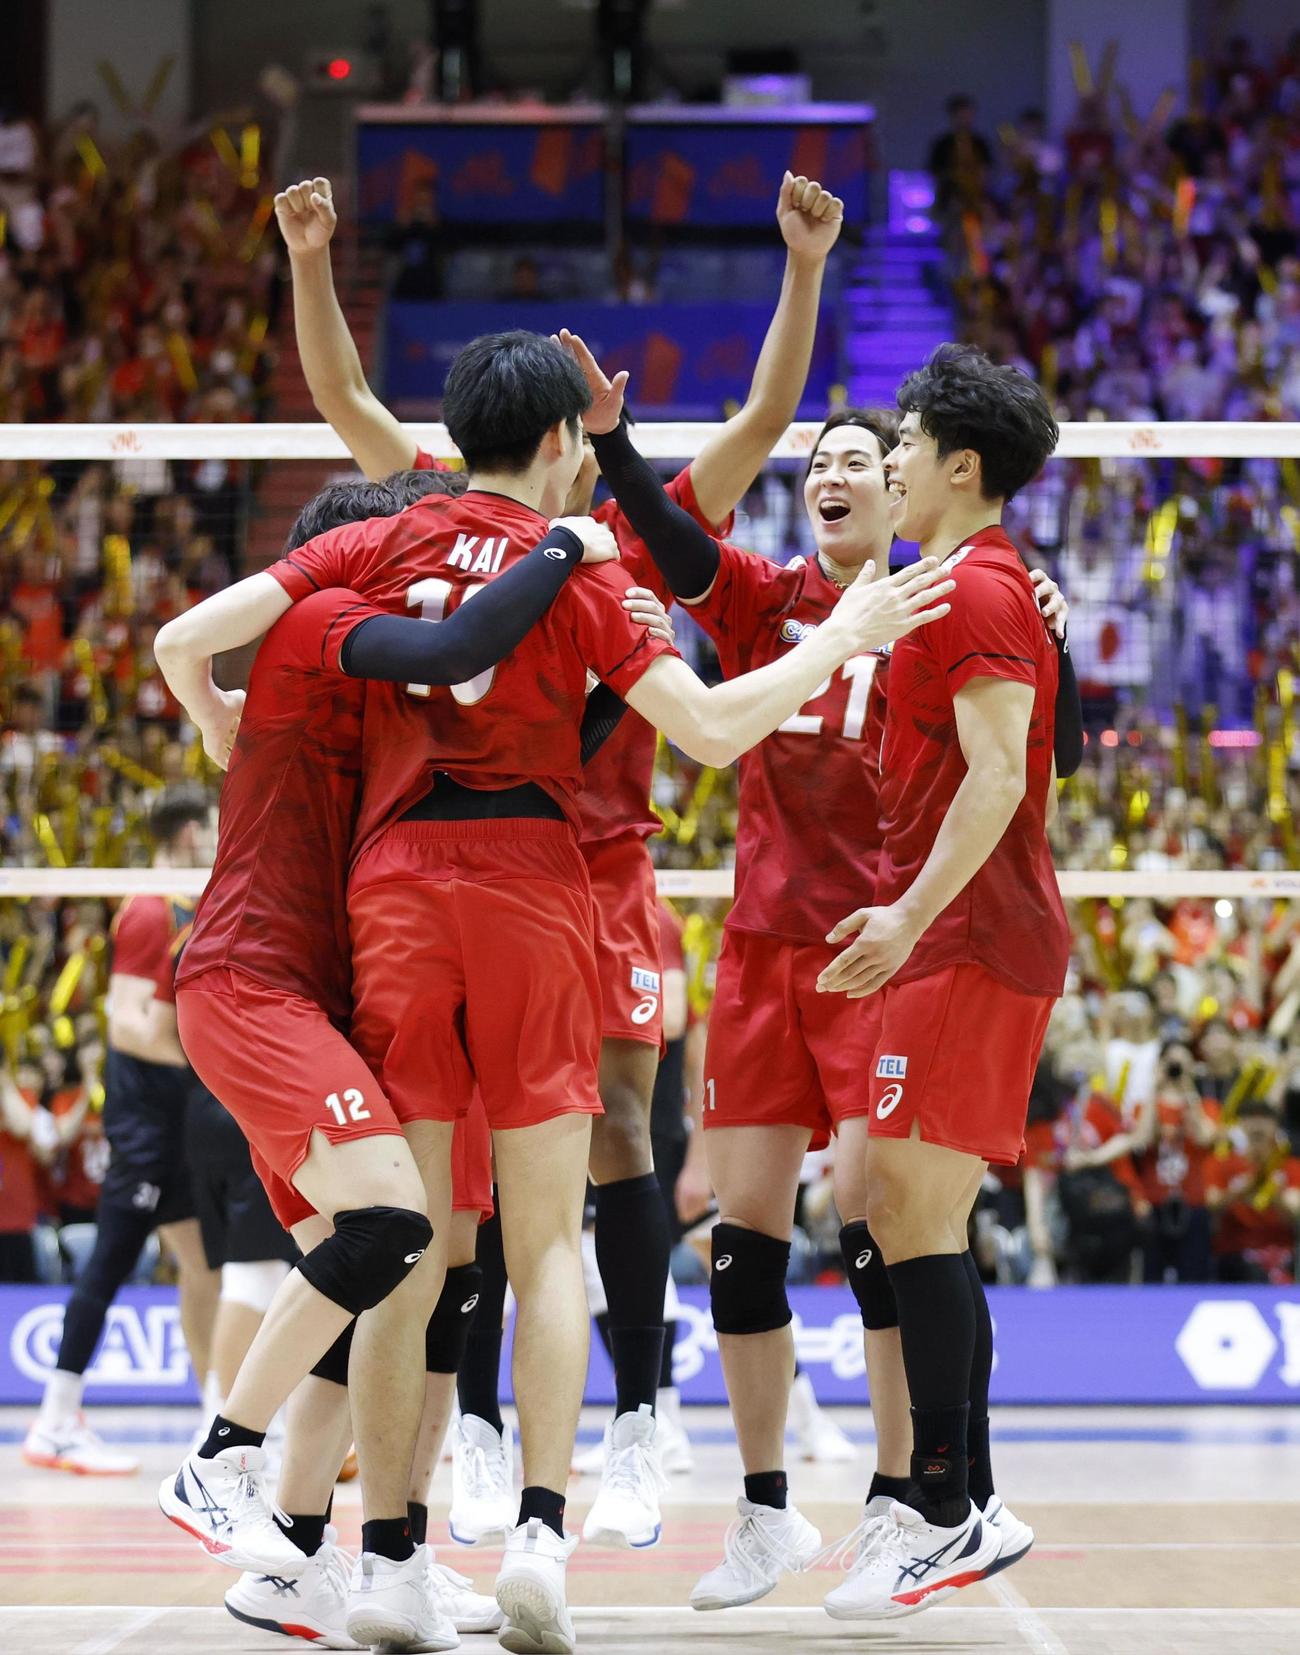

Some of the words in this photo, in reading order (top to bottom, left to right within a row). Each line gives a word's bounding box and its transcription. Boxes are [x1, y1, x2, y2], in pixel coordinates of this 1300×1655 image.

[446, 533, 509, 573] KAI
[633, 970, 658, 990] TEL
[879, 1059, 905, 1075] TEL
[325, 1088, 371, 1126] 12
